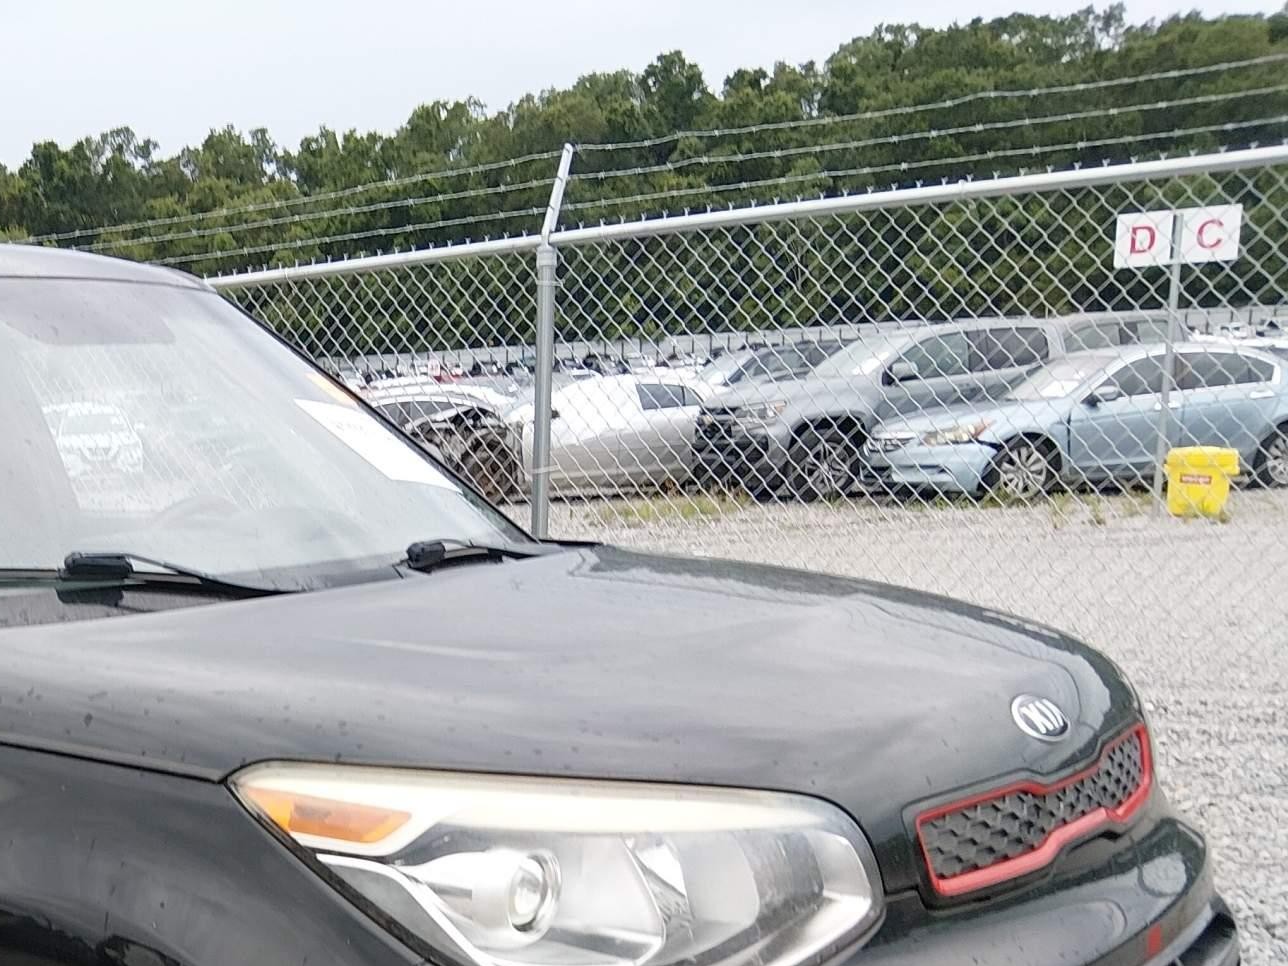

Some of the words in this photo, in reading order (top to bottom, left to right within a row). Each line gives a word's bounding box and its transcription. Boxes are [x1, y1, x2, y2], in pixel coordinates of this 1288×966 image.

[1129, 225, 1156, 254] D
[1196, 218, 1224, 249] C
[1017, 697, 1066, 736] KIA
